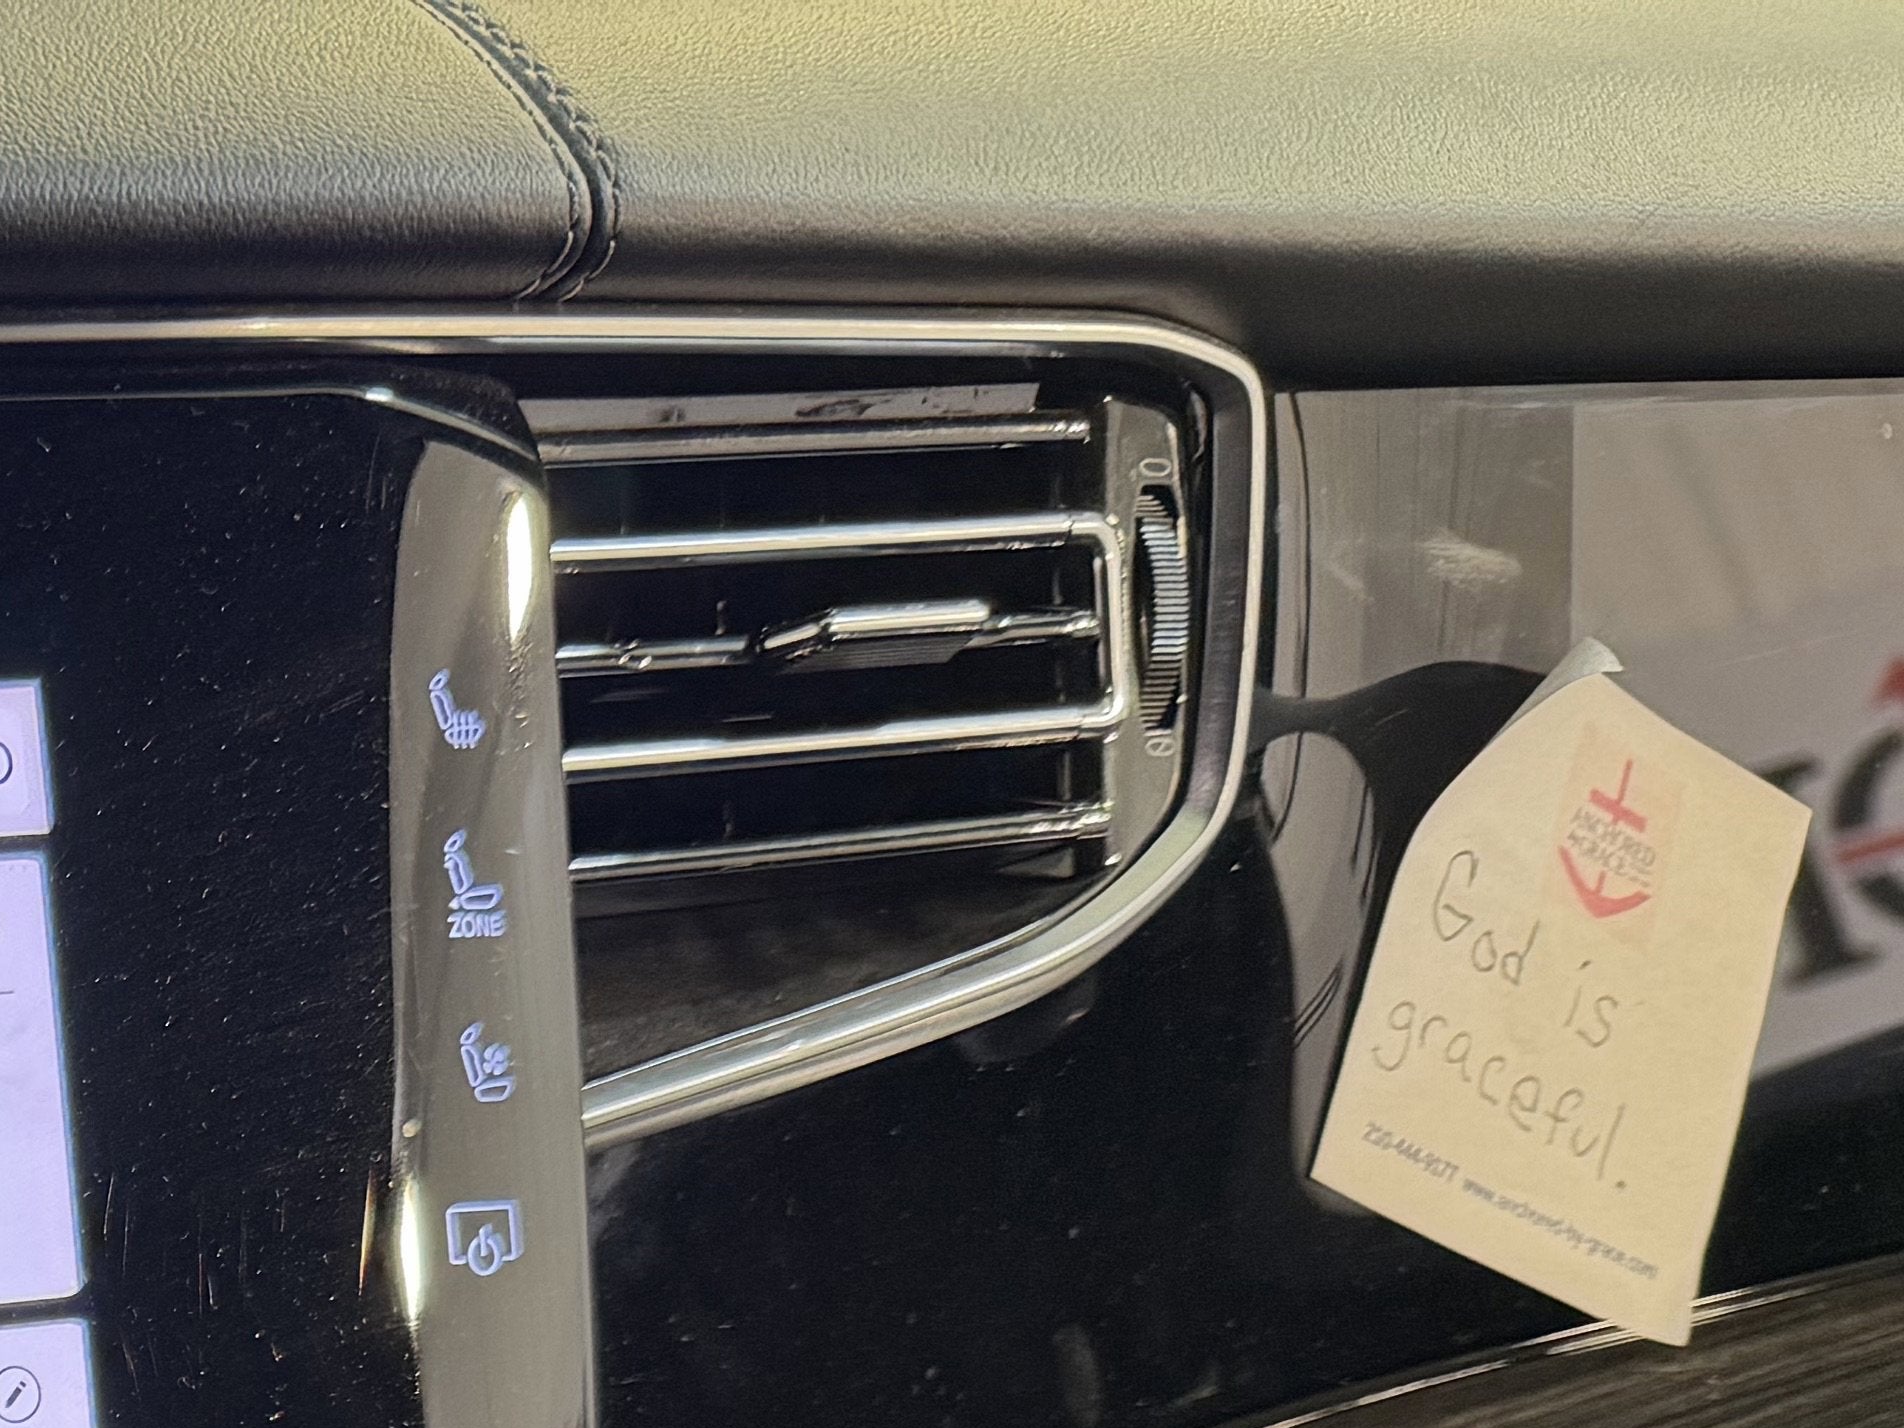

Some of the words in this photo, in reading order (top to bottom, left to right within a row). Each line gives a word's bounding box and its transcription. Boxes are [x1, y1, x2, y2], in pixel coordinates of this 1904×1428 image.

[446, 910, 505, 938] ZONE
[1433, 850, 1542, 986] God
[1567, 959, 1618, 1048] is
[1371, 1000, 1628, 1191] graceful.
